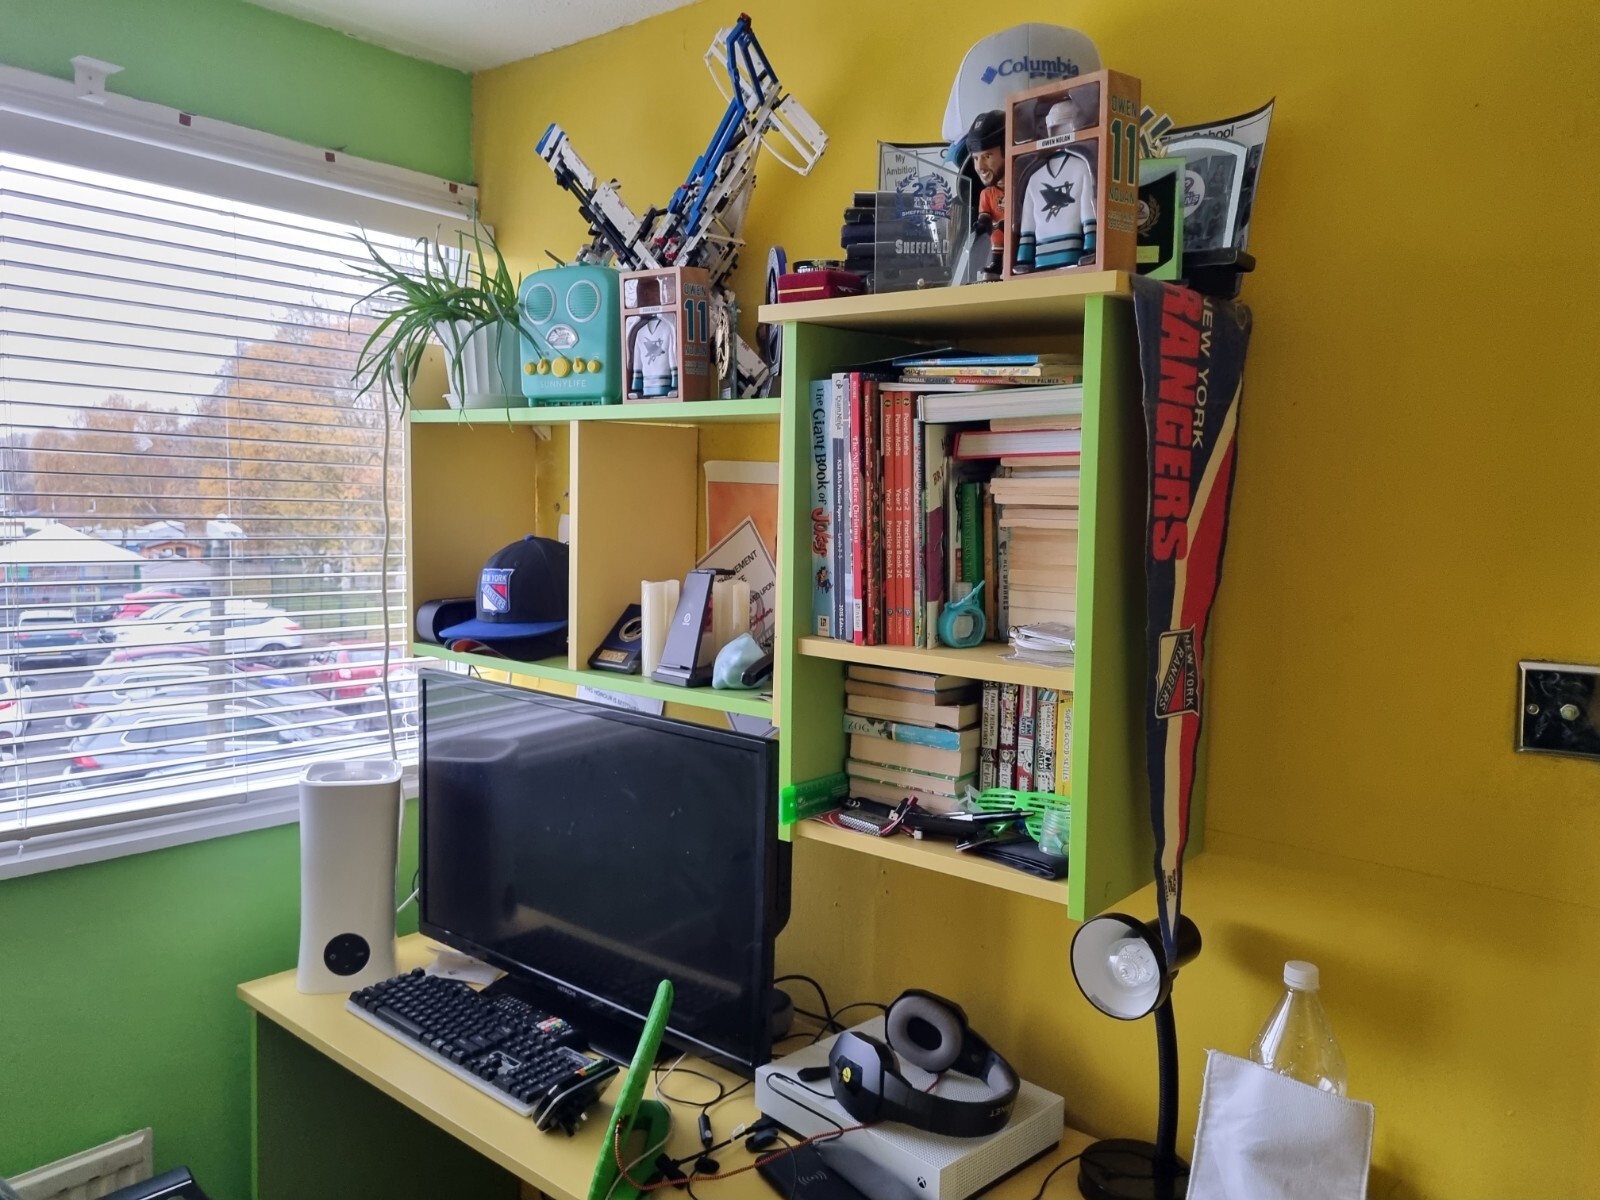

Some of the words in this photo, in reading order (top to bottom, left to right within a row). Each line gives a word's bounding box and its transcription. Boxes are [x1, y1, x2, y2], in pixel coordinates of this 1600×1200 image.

[998, 55, 1079, 77] Columbia
[1111, 95, 1137, 117] OWEN
[1042, 139, 1055, 147] OWEN
[1056, 134, 1071, 144] NOLAN
[895, 154, 906, 164] My
[1111, 118, 1137, 187] 11
[886, 166, 917, 176] Ambition
[912, 182, 937, 198] 25
[1109, 187, 1135, 206] NOLAN
[902, 209, 934, 217] SHEFFIELD
[895, 239, 950, 255] SHEFFIELD
[684, 283, 707, 297] OWEN
[684, 298, 708, 343] 11
[540, 380, 588, 389] SUNNYLIFE
[815, 385, 825, 406] The
[1191, 367, 1213, 449] YORK
[812, 408, 826, 452] Giant
[1152, 282, 1202, 561] RANGERS
[818, 492, 827, 505] of
[852, 476, 860, 503] Before
[903, 487, 911, 505] Year
[852, 504, 861, 544] Christmas
[492, 574, 507, 582] YORK
[887, 570, 893, 579] 2A
[896, 570, 903, 579] 2C
[760, 581, 775, 596] UPON
[1184, 634, 1194, 665] NEW
[1159, 646, 1185, 711] RANGERS
[1185, 670, 1195, 709] YORK
[848, 721, 870, 733] ZOG
[982, 712, 990, 746] CREATURES
[1064, 708, 1072, 731] SUPER
[1063, 732, 1071, 755] GOOD
[1037, 749, 1045, 770] GATES
[1045, 751, 1053, 771] TOM
[1062, 757, 1070, 781] SKILLS
